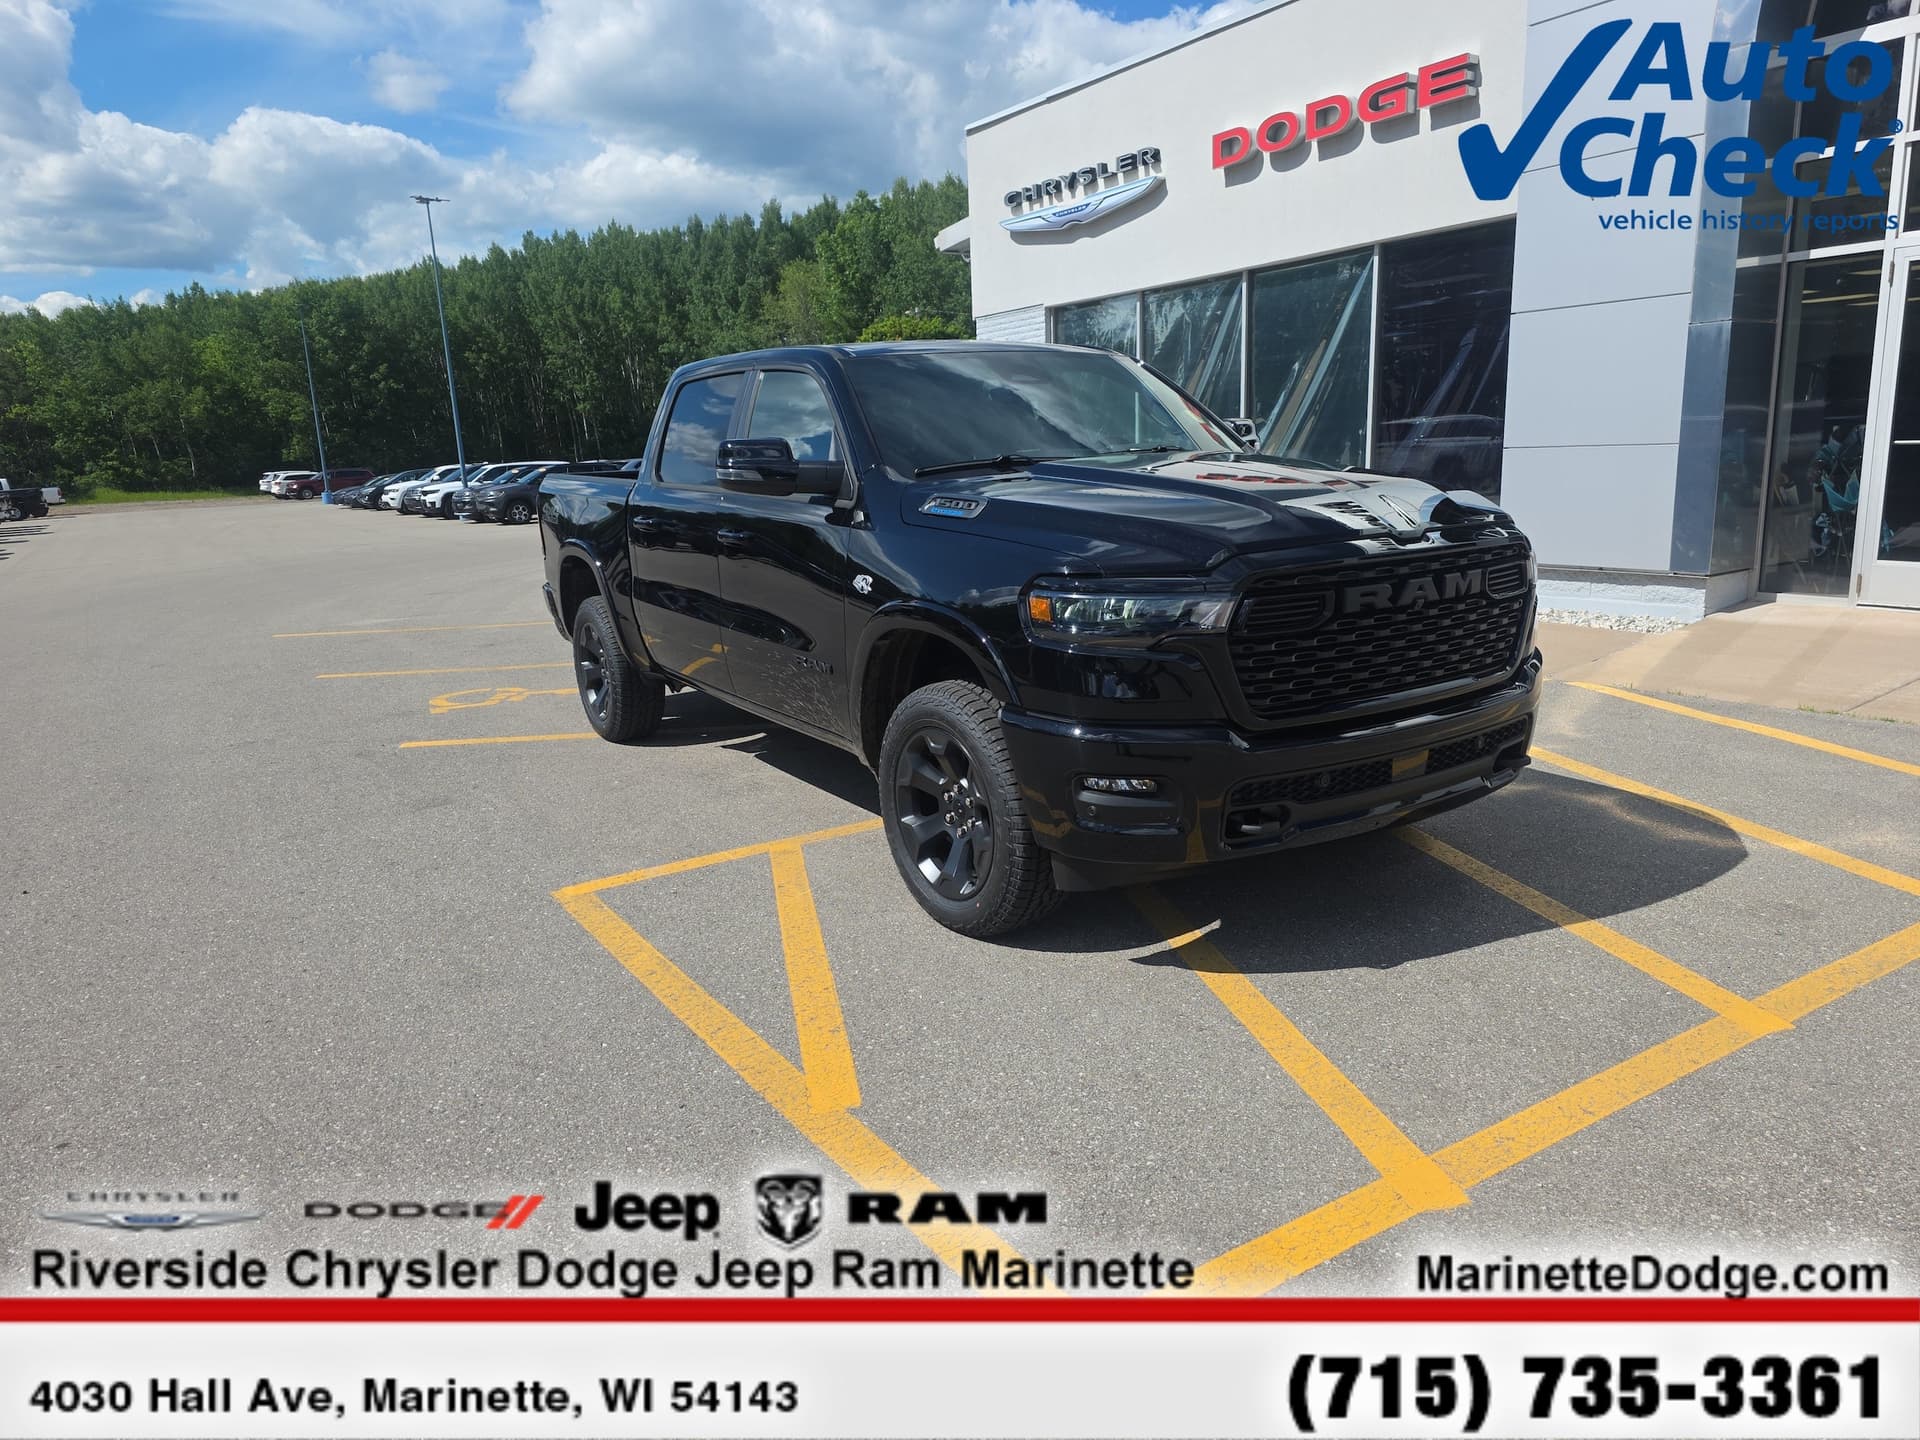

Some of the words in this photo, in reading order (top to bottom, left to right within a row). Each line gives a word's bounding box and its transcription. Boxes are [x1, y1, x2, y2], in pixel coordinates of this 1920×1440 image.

[1211, 52, 1481, 170] DODGE
[1004, 146, 1161, 208] CHRYSLER
[934, 498, 977, 510] 1500
[1343, 569, 1483, 614] RAM
